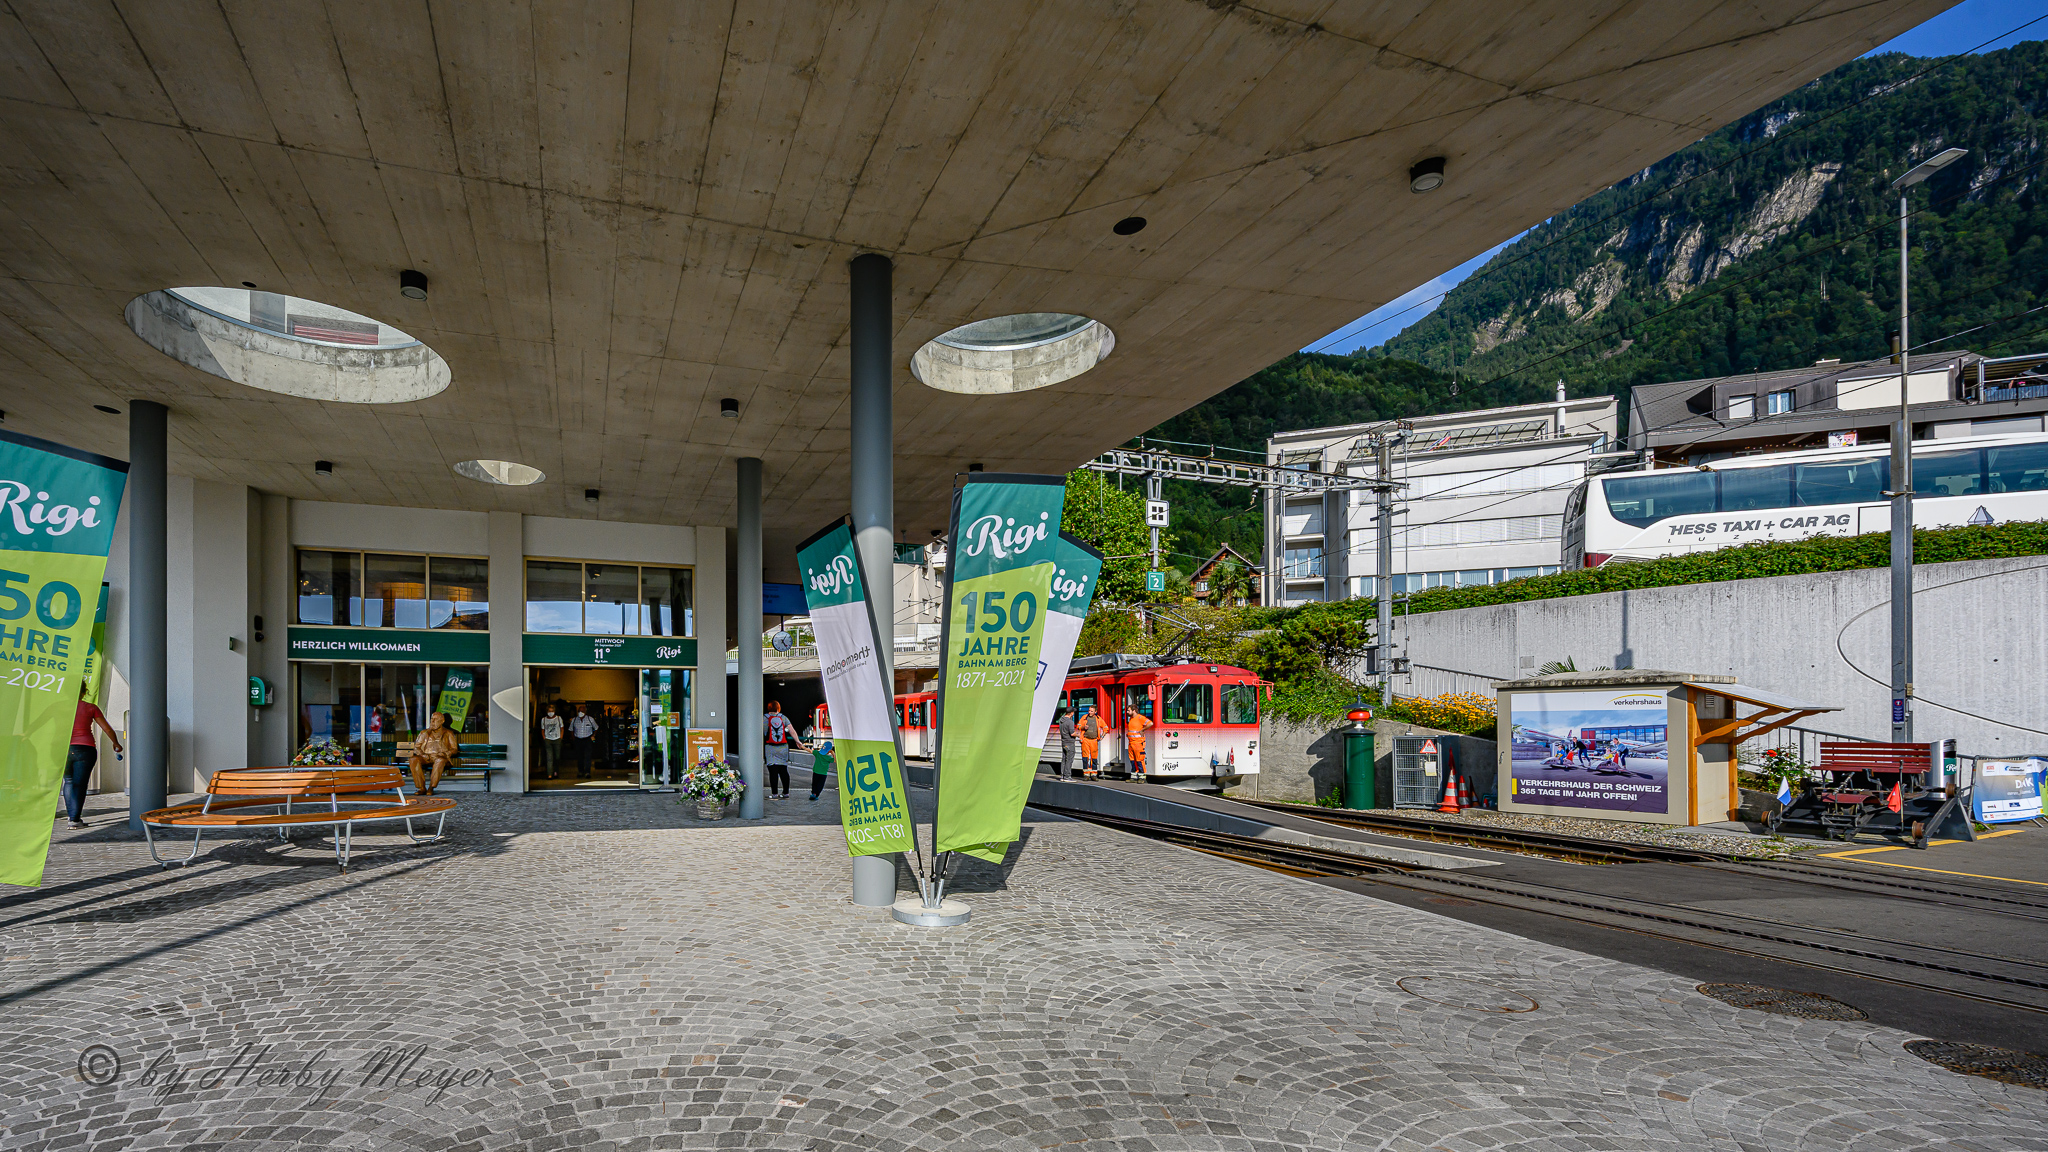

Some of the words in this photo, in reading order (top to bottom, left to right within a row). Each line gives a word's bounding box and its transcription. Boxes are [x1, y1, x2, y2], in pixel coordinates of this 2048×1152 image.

[1668, 522, 1717, 535] HESS
[1722, 519, 1762, 532] TAXI
[1764, 520, 1775, 529] +
[1779, 516, 1819, 529] CAR
[1823, 514, 1850, 527] AG
[966, 511, 1049, 558] Rigi
[912, 551, 916, 560] 1
[1153, 578, 1159, 587] 2
[0, 569, 82, 630] 50
[960, 591, 1037, 633] 150
[0, 624, 72, 658] HRE
[293, 640, 346, 650] HERZLICH
[348, 642, 421, 652] WILLKOMMEN
[959, 636, 1031, 657] JAHRE
[656, 645, 682, 659] Rigi
[27, 655, 67, 671] BERG
[958, 659, 986, 668] BAHN
[987, 659, 1004, 667] AM
[1005, 657, 1027, 667] BERG
[447, 676, 472, 689] Rigi
[444, 694, 467, 708] 150
[1613, 698, 1662, 706] verkehrshaus
[1162, 761, 1179, 771] Rigi
[1520, 779, 1591, 790] VERKEHRSHAUS
[1593, 782, 1613, 791] DER
[1615, 784, 1662, 793] SCHWEIZ
[1520, 787, 1536, 795] 365
[1537, 788, 1561, 797] TAGE
[1575, 790, 1601, 799] JAHR
[1602, 792, 1638, 801] OFFEN!
